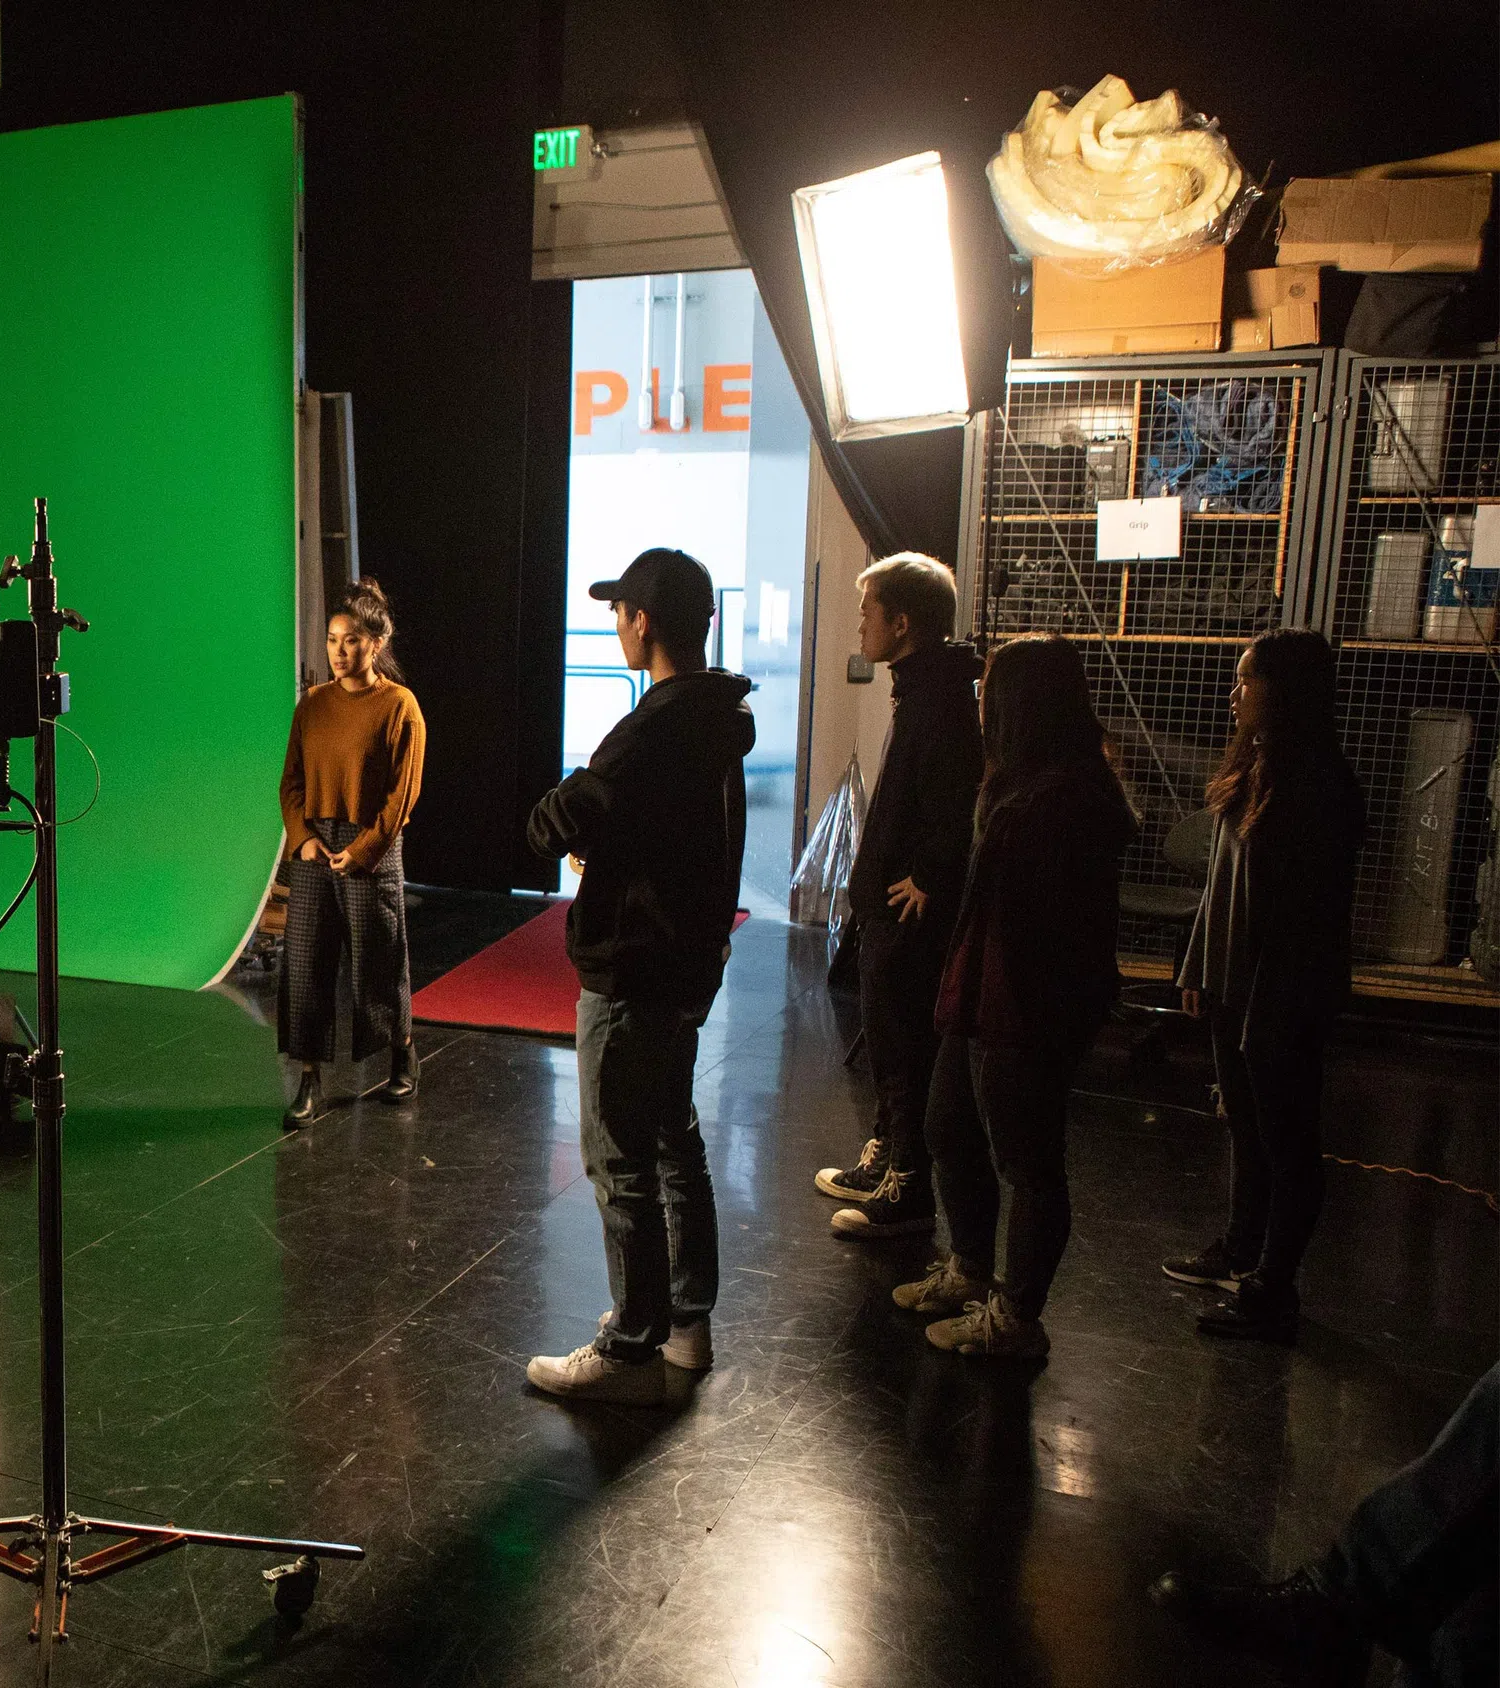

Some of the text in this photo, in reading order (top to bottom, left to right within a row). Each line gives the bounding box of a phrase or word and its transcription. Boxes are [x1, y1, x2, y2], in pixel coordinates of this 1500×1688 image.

[534, 129, 580, 170] EXIT
[574, 363, 752, 436] PLE
[1129, 521, 1149, 530] Grip
[1412, 835, 1434, 877] KIT
